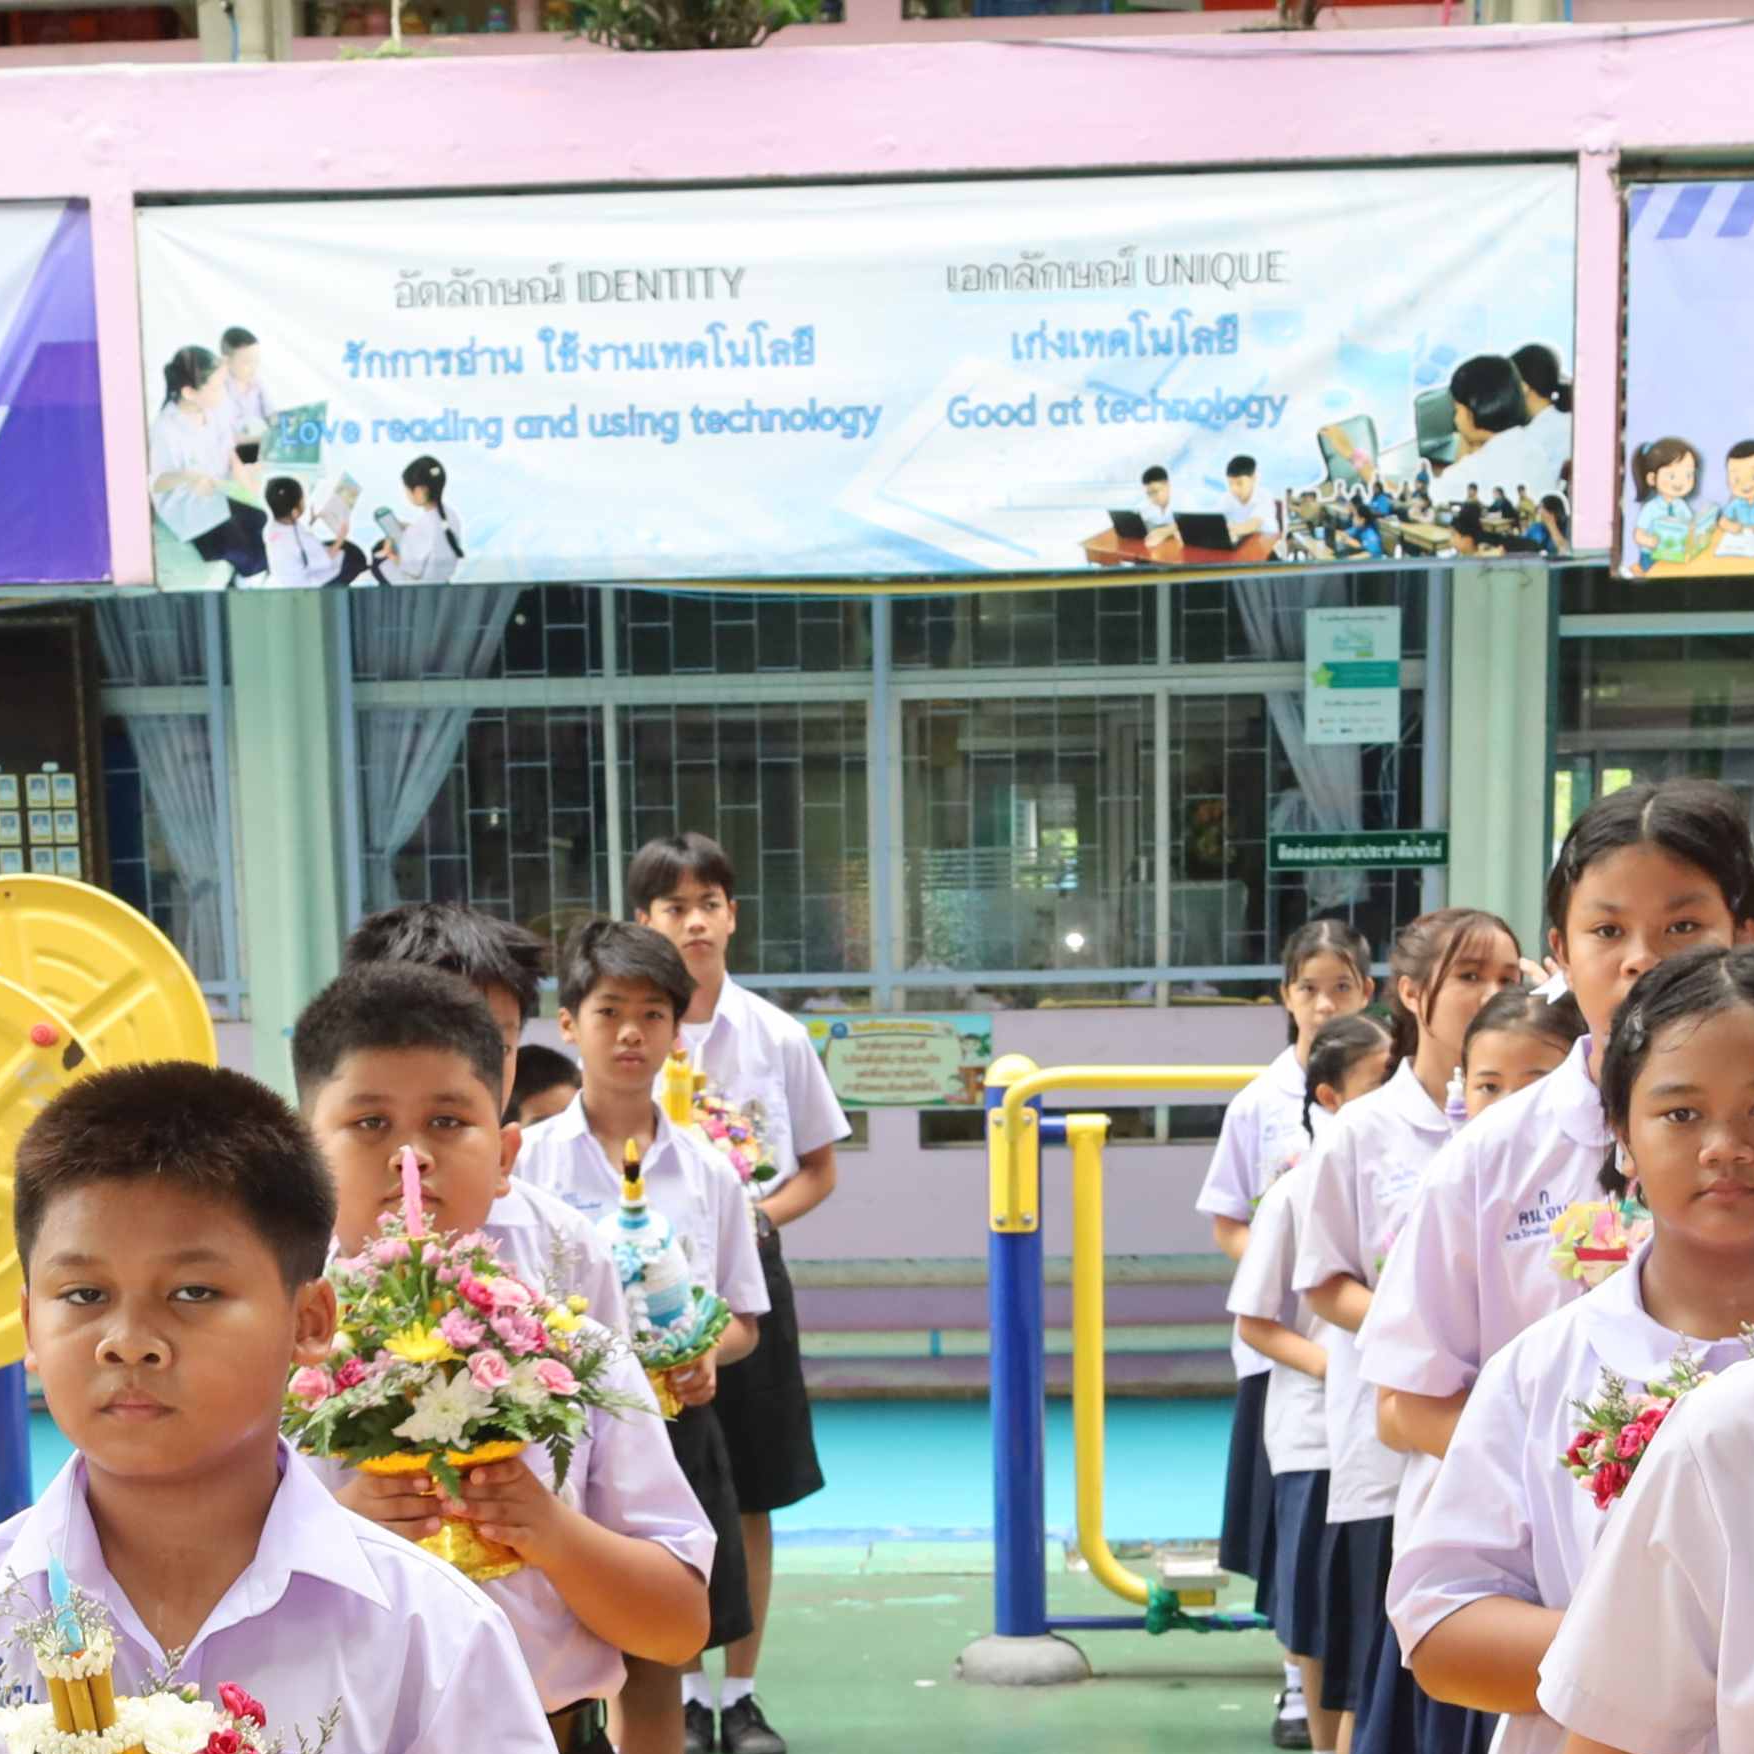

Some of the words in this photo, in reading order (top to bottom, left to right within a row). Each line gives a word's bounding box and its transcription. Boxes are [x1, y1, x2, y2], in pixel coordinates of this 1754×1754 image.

[577, 266, 746, 303] IDENTITY
[946, 246, 1138, 293] เอกลักษณ์
[1145, 250, 1290, 291] UNIQUE
[342, 336, 525, 379] รักการอ่าน
[537, 320, 816, 372] ใช้งานเทคโนโลยี
[1011, 308, 1239, 360] เก่งเทคโนโลยี
[279, 415, 361, 446] Love
[371, 408, 504, 449] reading
[513, 403, 578, 440] and
[588, 404, 681, 445] using
[690, 397, 883, 440] technology
[947, 392, 1037, 429] Good
[1047, 395, 1083, 426] at
[1095, 386, 1289, 428] technology
